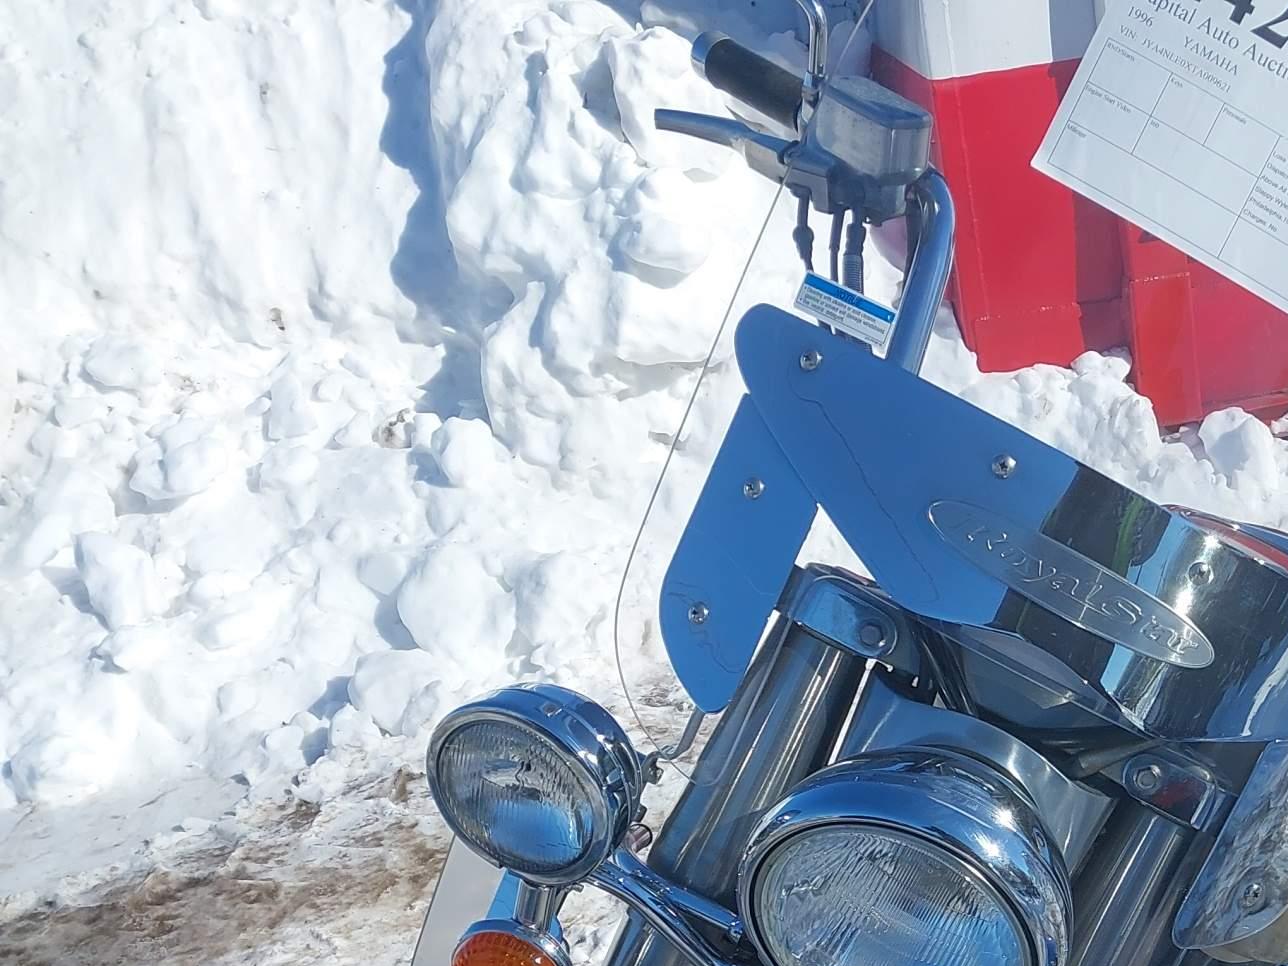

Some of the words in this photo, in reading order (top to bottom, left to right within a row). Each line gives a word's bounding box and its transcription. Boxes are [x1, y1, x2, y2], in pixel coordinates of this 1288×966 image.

[1128, 6, 1153, 27] 1996
[1184, 36, 1238, 76] YAMAHA
[1197, 16, 1240, 49] Auto
